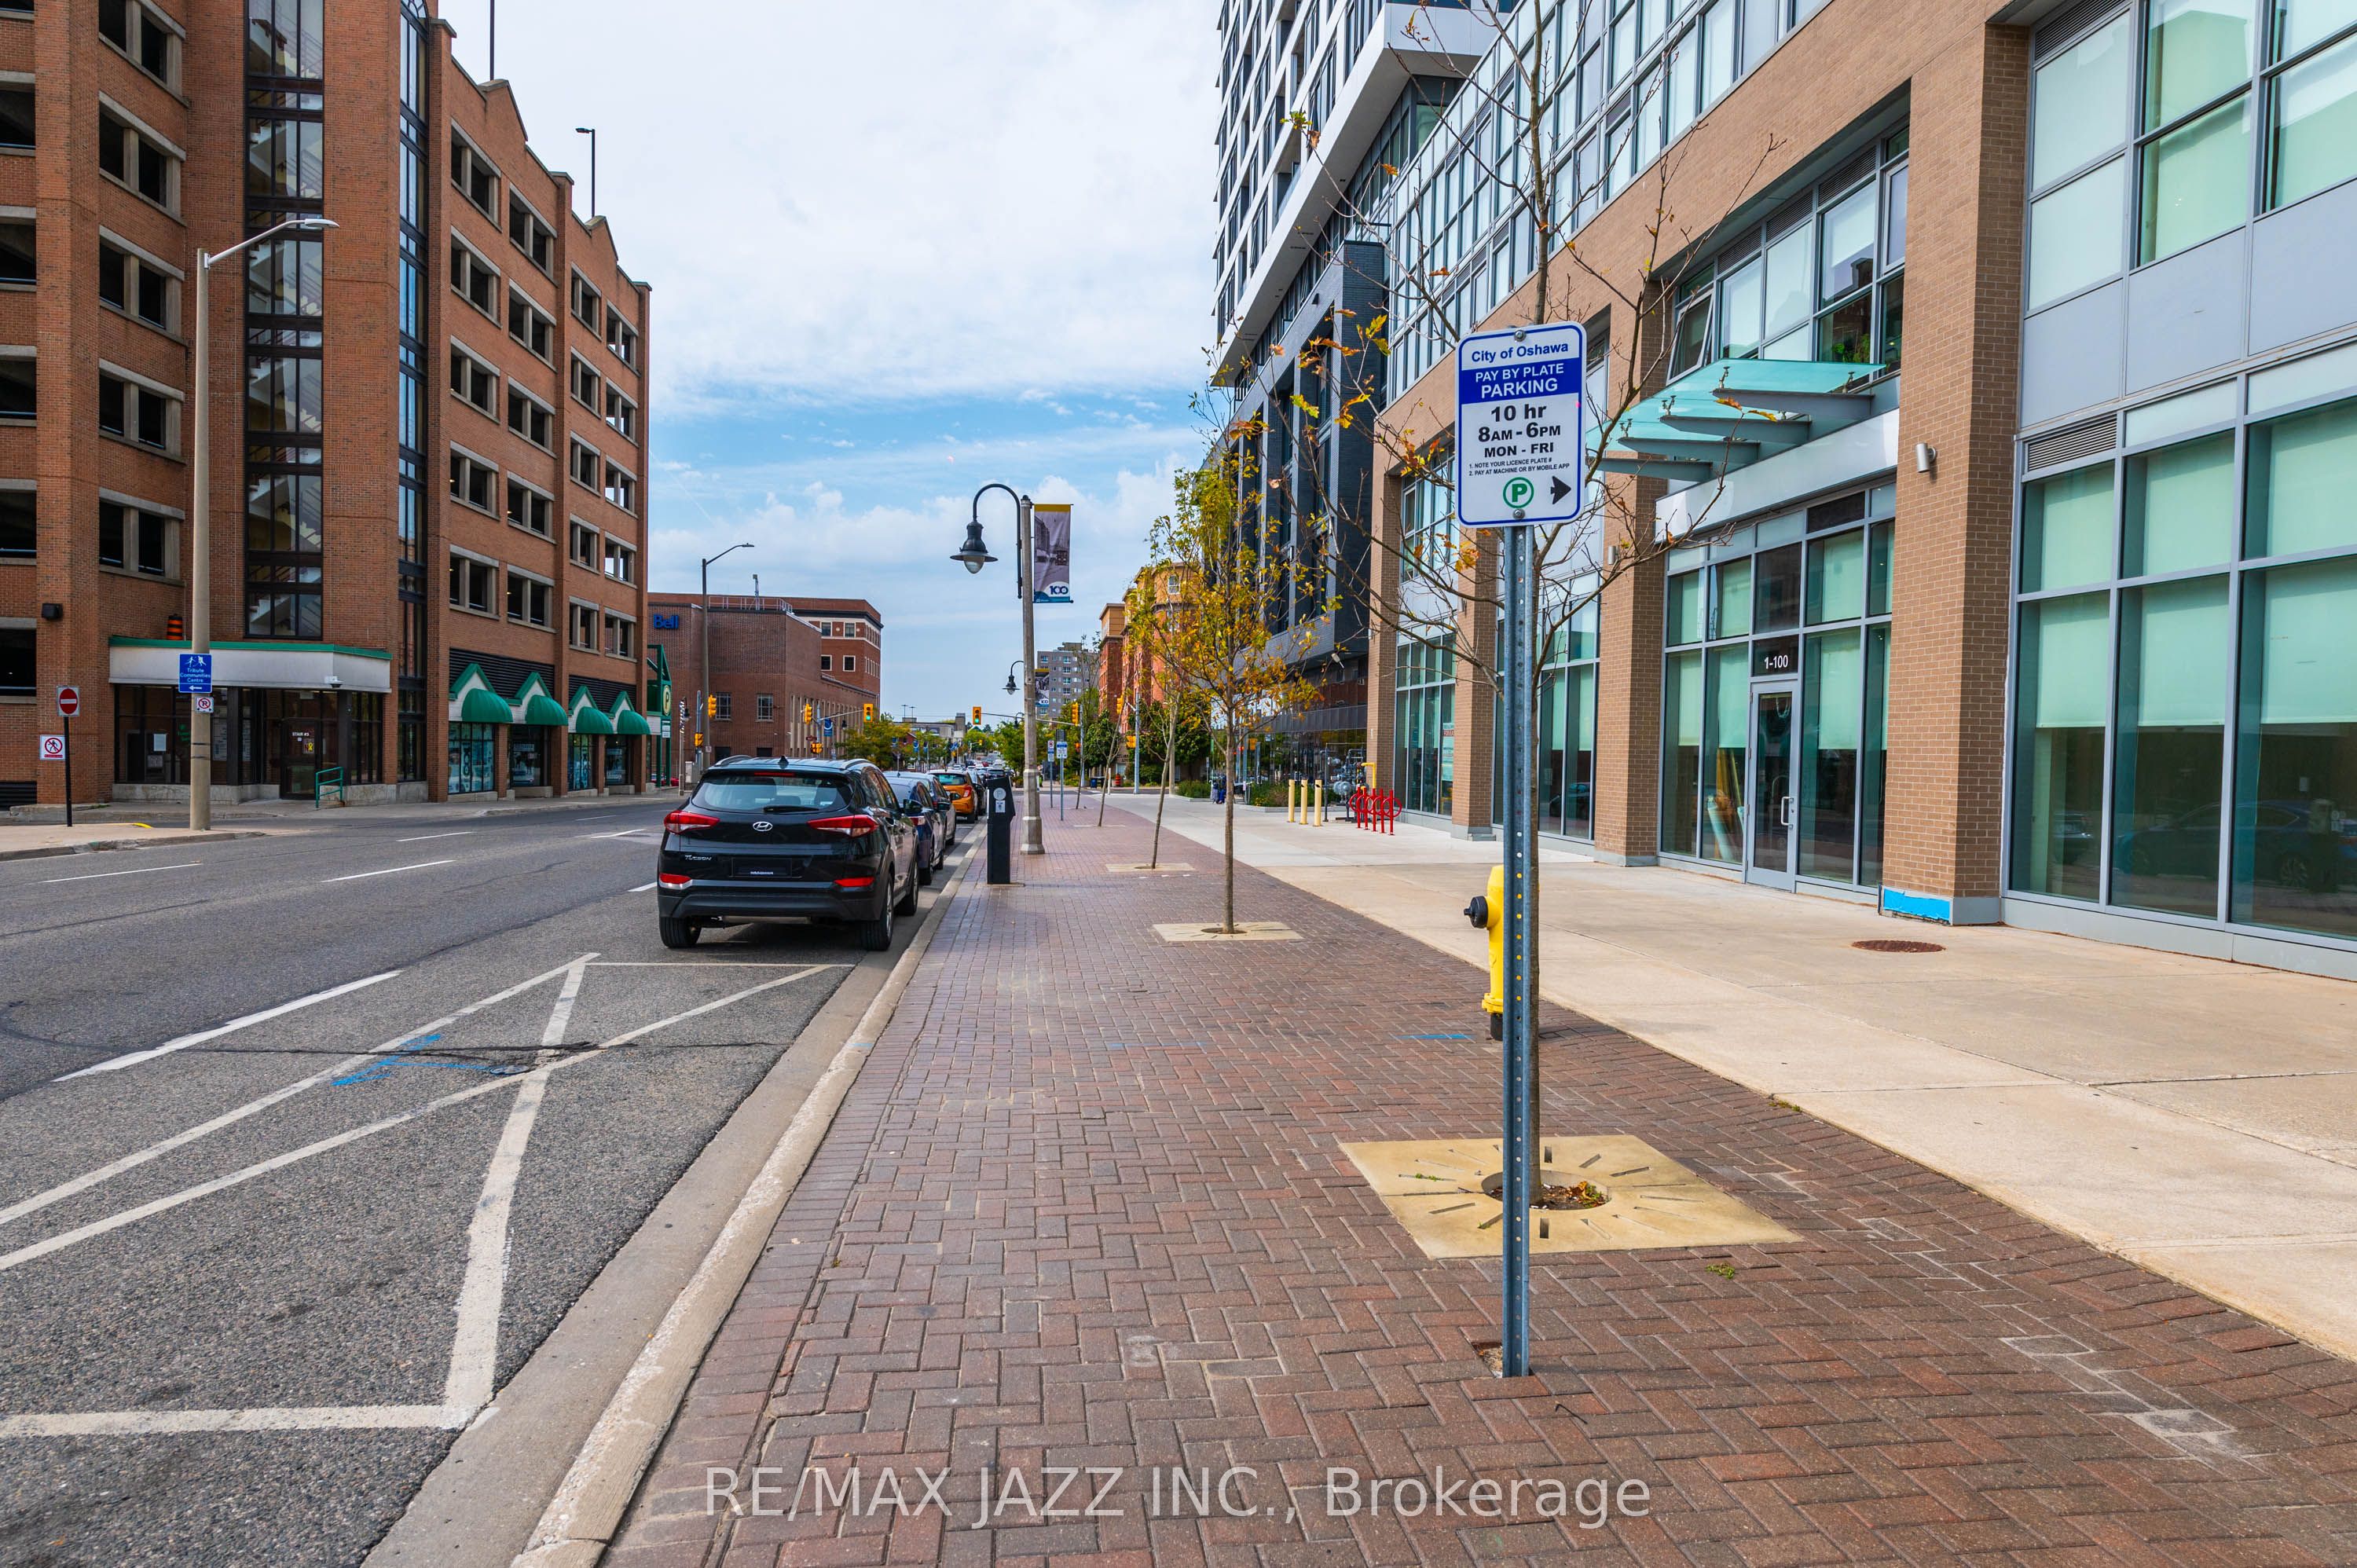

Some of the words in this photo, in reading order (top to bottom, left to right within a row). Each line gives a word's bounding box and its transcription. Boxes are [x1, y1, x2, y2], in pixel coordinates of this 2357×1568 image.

[1472, 350, 1496, 363] City
[1500, 347, 1513, 359] of
[1516, 343, 1568, 357] Oshawa
[1475, 370, 1499, 383] PAY
[1502, 367, 1519, 379] BY
[1523, 363, 1564, 377] PLATE
[1481, 378, 1558, 398] PARKING
[1491, 405, 1516, 422] 10
[1524, 403, 1547, 419] hr
[1478, 427, 1512, 442] 8AM
[1526, 422, 1561, 438] 6PM
[1484, 445, 1517, 457] MON
[1530, 442, 1554, 454] FRI
[1512, 483, 1528, 503] P
[1050, 585, 1069, 595] 100
[653, 614, 679, 629] Bell
[1764, 654, 1789, 669] 1-100
